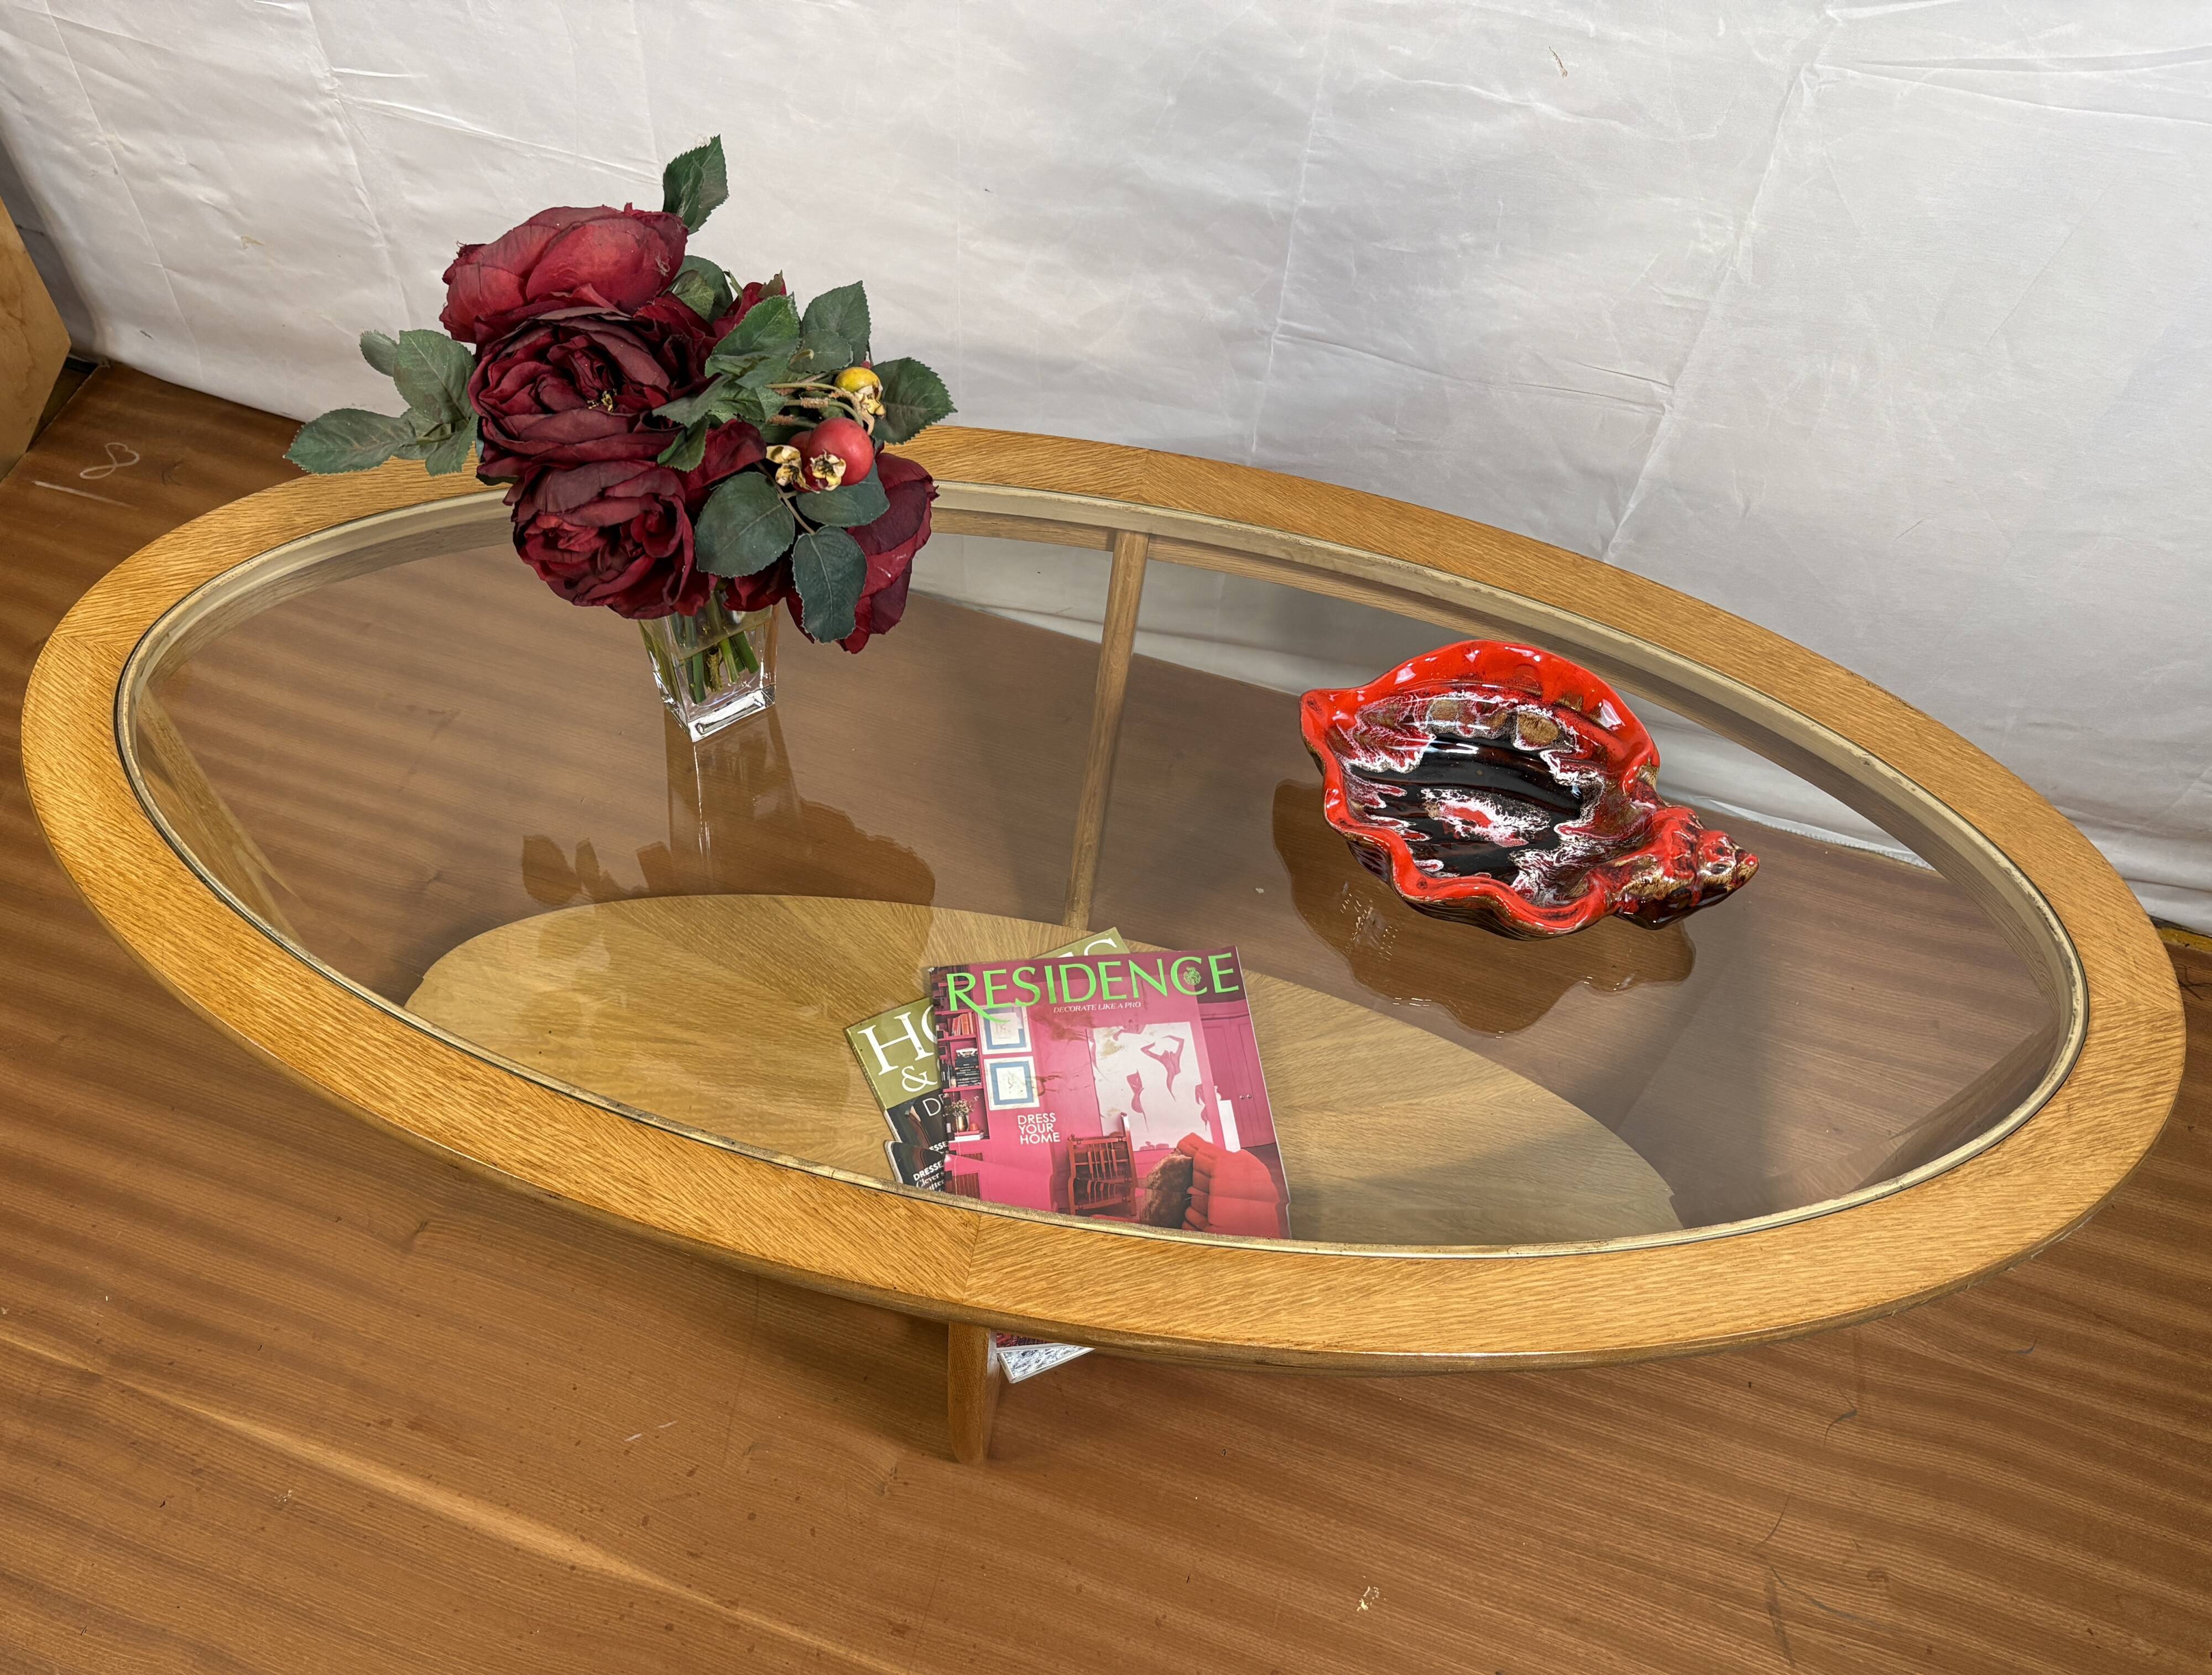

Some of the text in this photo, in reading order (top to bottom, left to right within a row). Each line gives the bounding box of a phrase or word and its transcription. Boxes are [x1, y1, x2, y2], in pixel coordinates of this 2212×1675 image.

[946, 952, 1239, 1024] RESIDENCE
[1053, 1004, 1097, 1013] DECORATE
[901, 1065, 938, 1092] &
[1018, 1113, 1056, 1125] DRESS
[1018, 1123, 1054, 1135] YOUR
[1020, 1132, 1061, 1145] HOME
